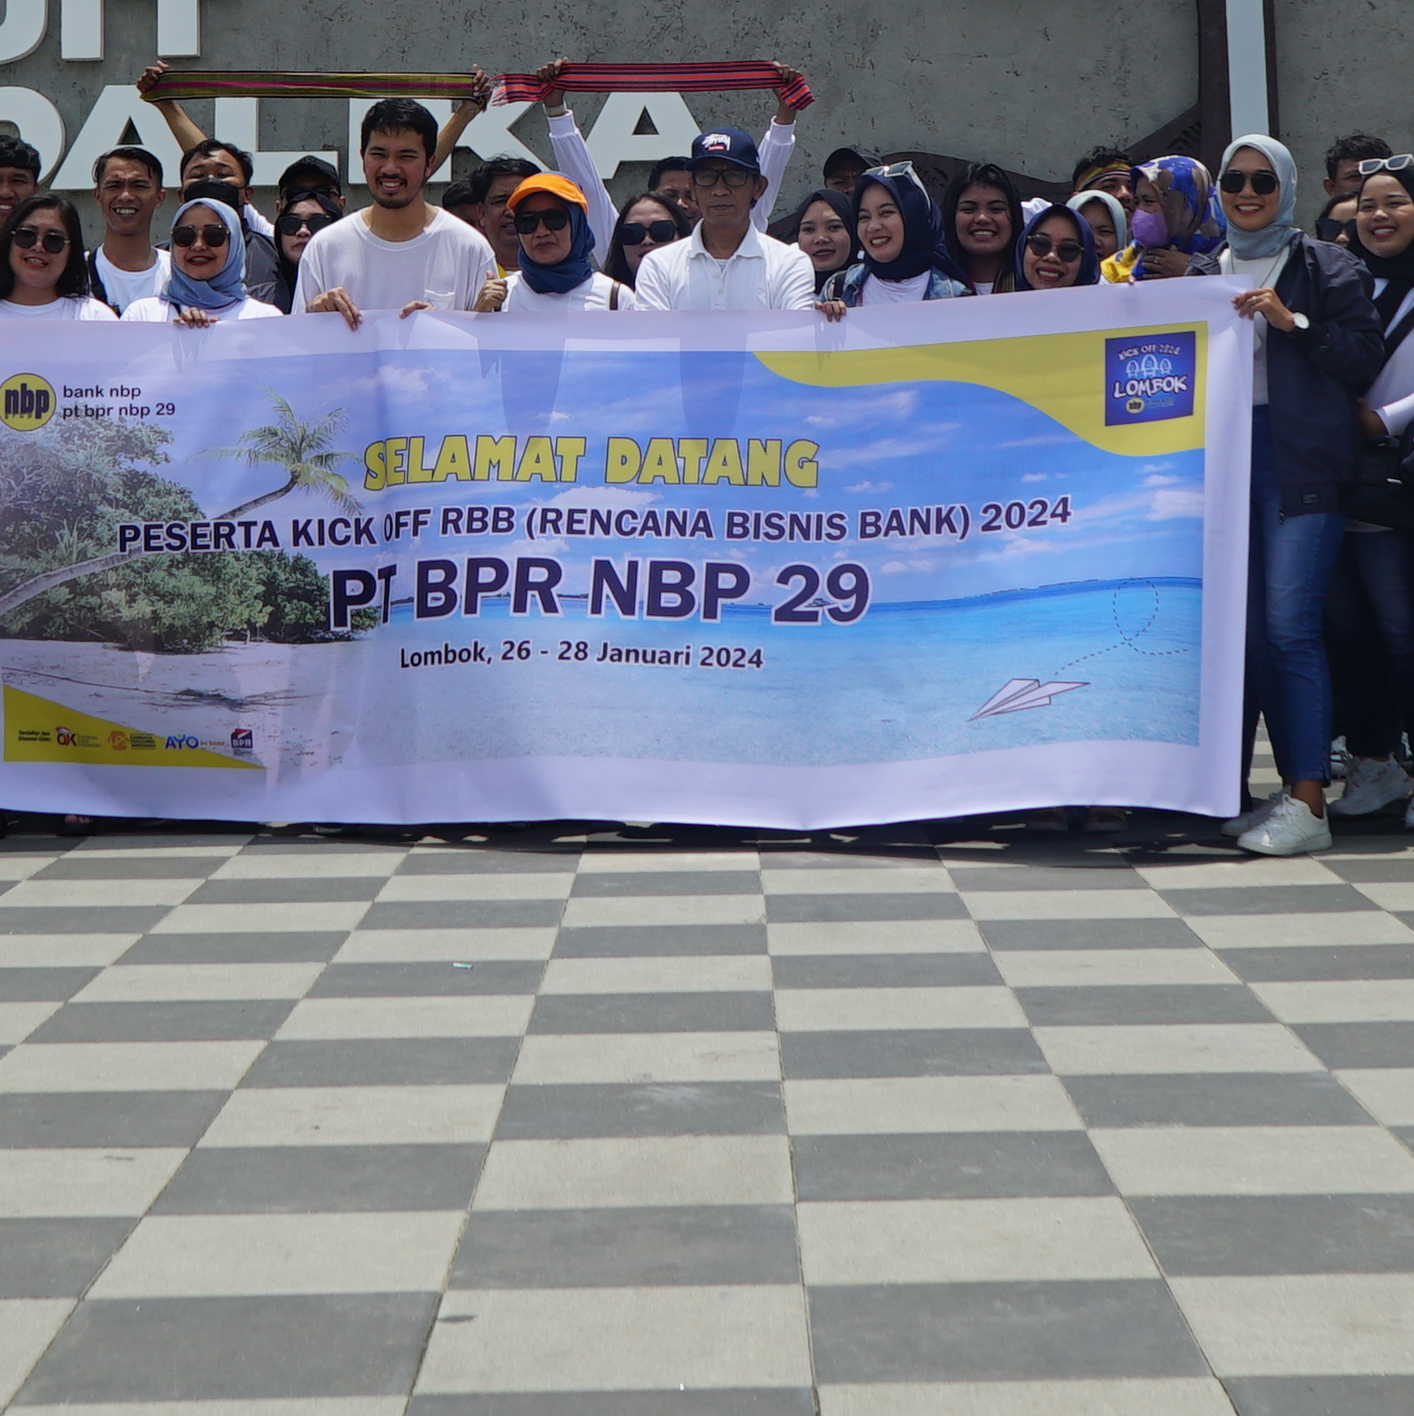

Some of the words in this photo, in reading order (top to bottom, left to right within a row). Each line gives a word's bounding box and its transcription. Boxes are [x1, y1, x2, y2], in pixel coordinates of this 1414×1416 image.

[1118, 347, 1139, 361] KICK
[1141, 344, 1157, 354] OFF
[63, 385, 104, 399] bank
[109, 385, 141, 400] nbp
[1113, 375, 1188, 399] LOMBOK
[4, 383, 49, 419] nbp
[62, 405, 79, 420] pt
[85, 403, 114, 420] bpr
[119, 403, 150, 419] nbp
[155, 402, 176, 416] 29
[364, 435, 587, 491] SELAMAT
[605, 437, 820, 488] DATANG
[118, 520, 279, 553] PESERTA
[292, 516, 377, 547] KICK
[384, 509, 431, 541] OFF
[441, 506, 515, 535] RBB
[526, 506, 714, 540] (RENCANA
[725, 510, 848, 541] BISNIS
[858, 504, 970, 540] BANK)
[980, 496, 1071, 532] 2024
[332, 563, 397, 628] PT
[415, 557, 562, 620] BPR
[589, 559, 751, 622] NBP
[773, 562, 870, 623] 29
[399, 642, 493, 668] Lombok,
[501, 640, 531, 661] 26
[558, 640, 588, 661] 28
[597, 642, 690, 666] Januari
[699, 646, 764, 668] 2024
[165, 734, 199, 750] AYO
[232, 738, 252, 747] BPR
